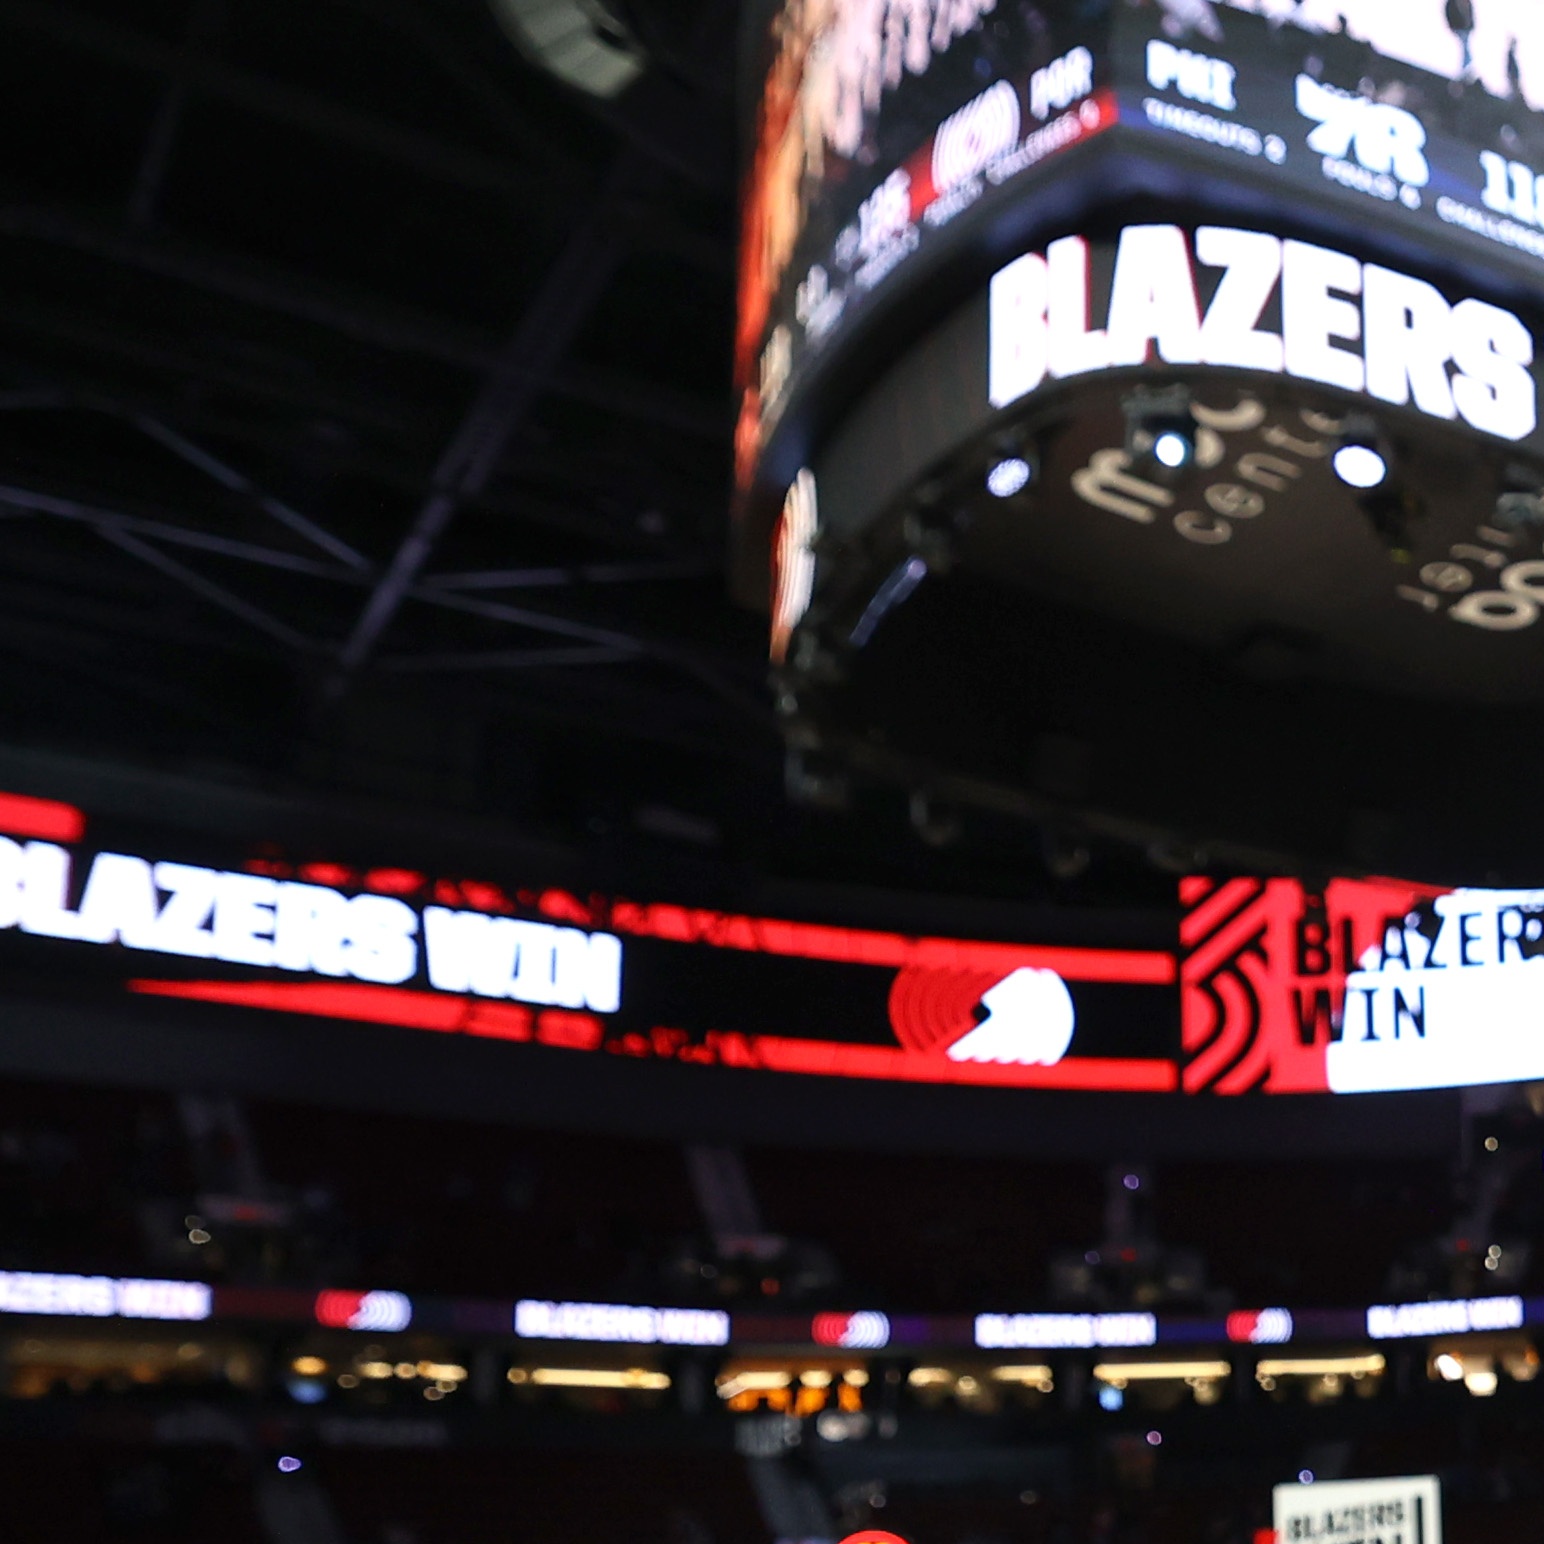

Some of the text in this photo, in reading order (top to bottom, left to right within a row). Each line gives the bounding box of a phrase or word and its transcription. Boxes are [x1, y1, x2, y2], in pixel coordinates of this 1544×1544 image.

[989, 224, 1534, 441] BLAZERS
[423, 905, 622, 1014] WIN
[1292, 985, 1426, 1046] WIN
[1287, 1501, 1404, 1541] BLAZERS
